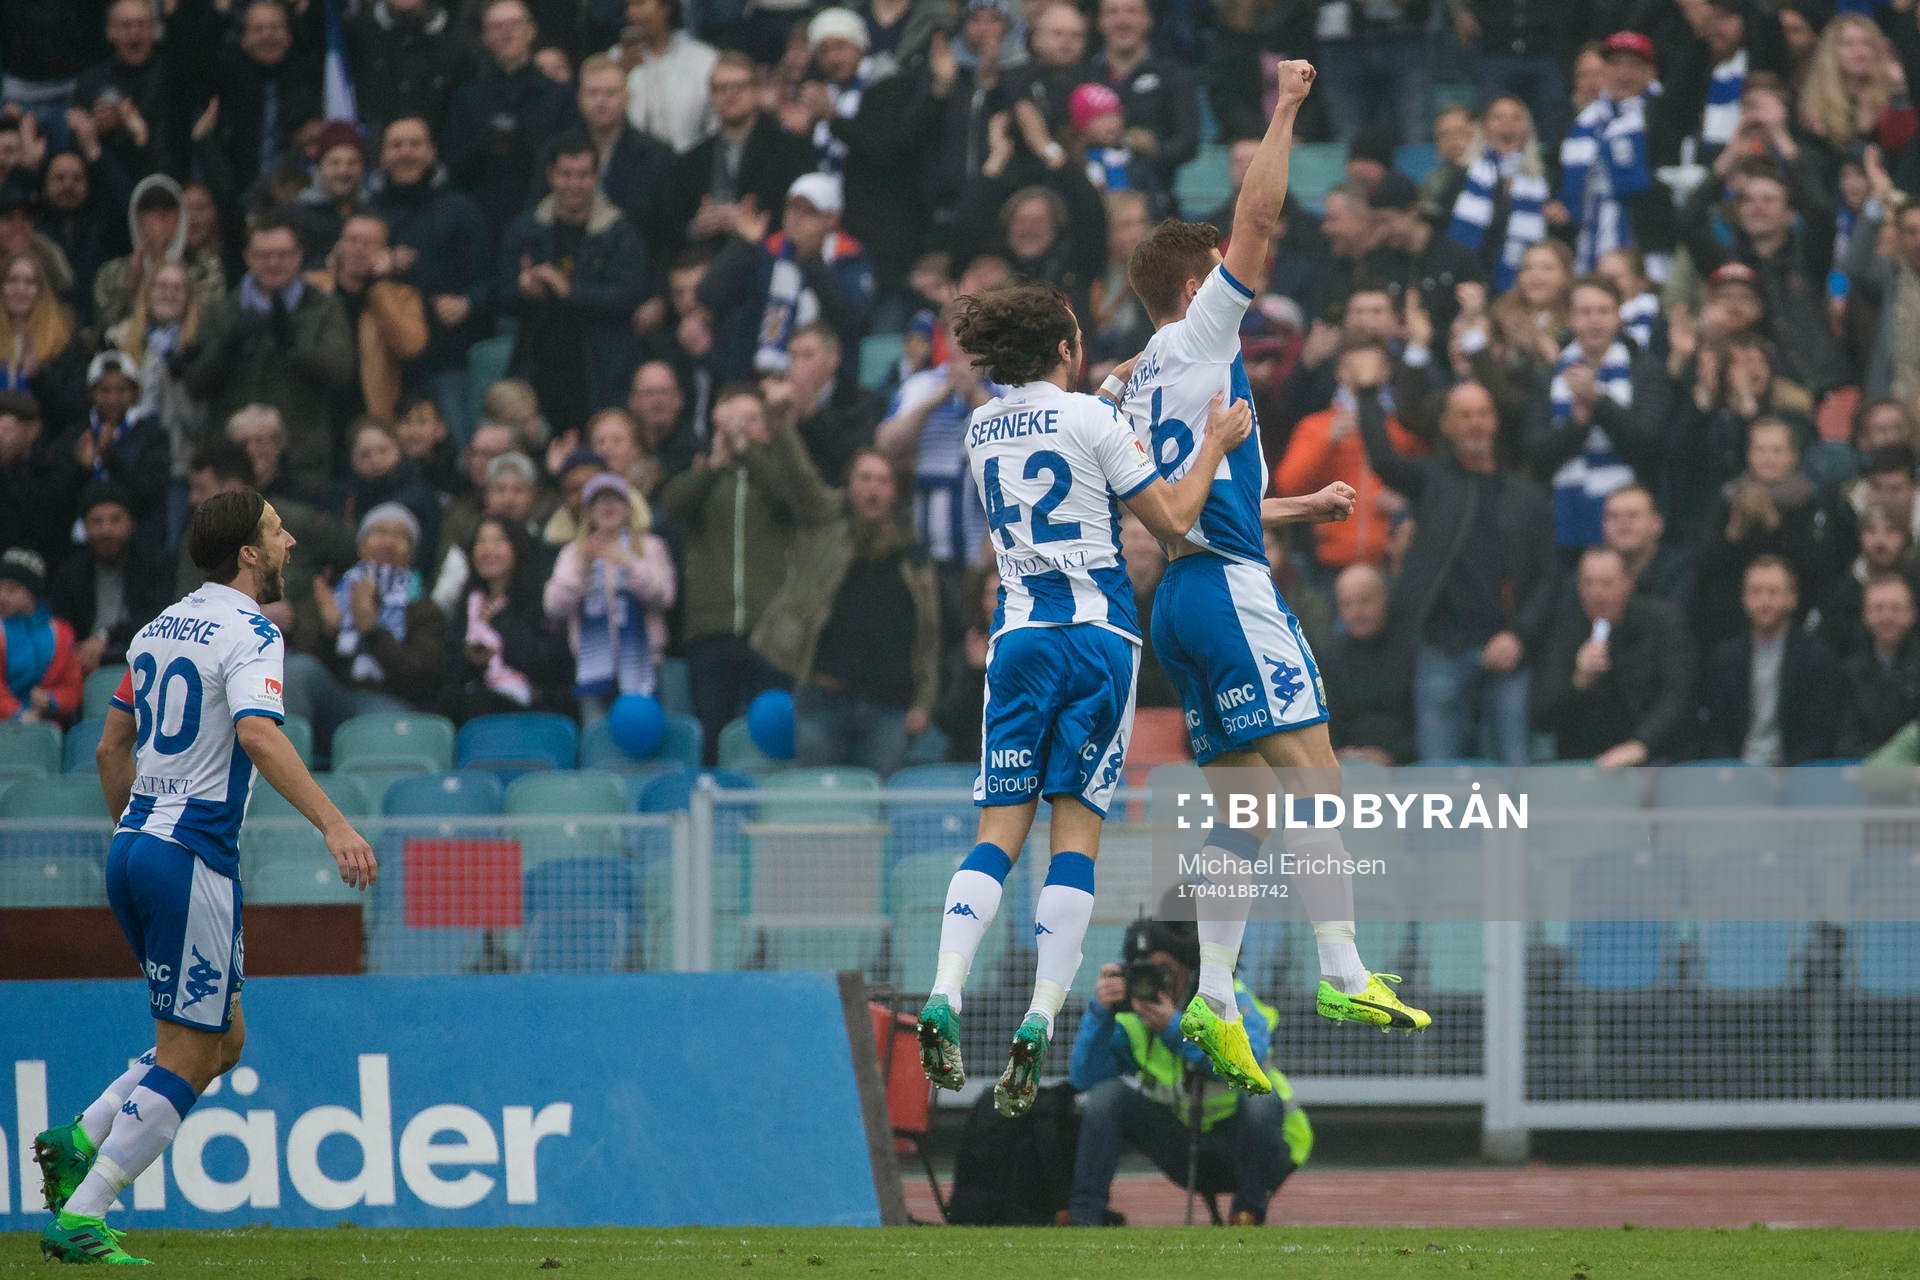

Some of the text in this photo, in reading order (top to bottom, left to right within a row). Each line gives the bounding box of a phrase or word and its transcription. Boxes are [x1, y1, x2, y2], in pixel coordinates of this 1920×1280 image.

[970, 409, 1059, 449] SERNEKE
[1129, 385, 1195, 480] 6
[983, 450, 1082, 550] 42
[142, 615, 221, 646] SERNEKE
[133, 651, 203, 756] 30
[1216, 683, 1256, 711] NRC
[1221, 708, 1268, 735] Group
[991, 749, 1033, 769] NRC
[987, 775, 1038, 794] Group
